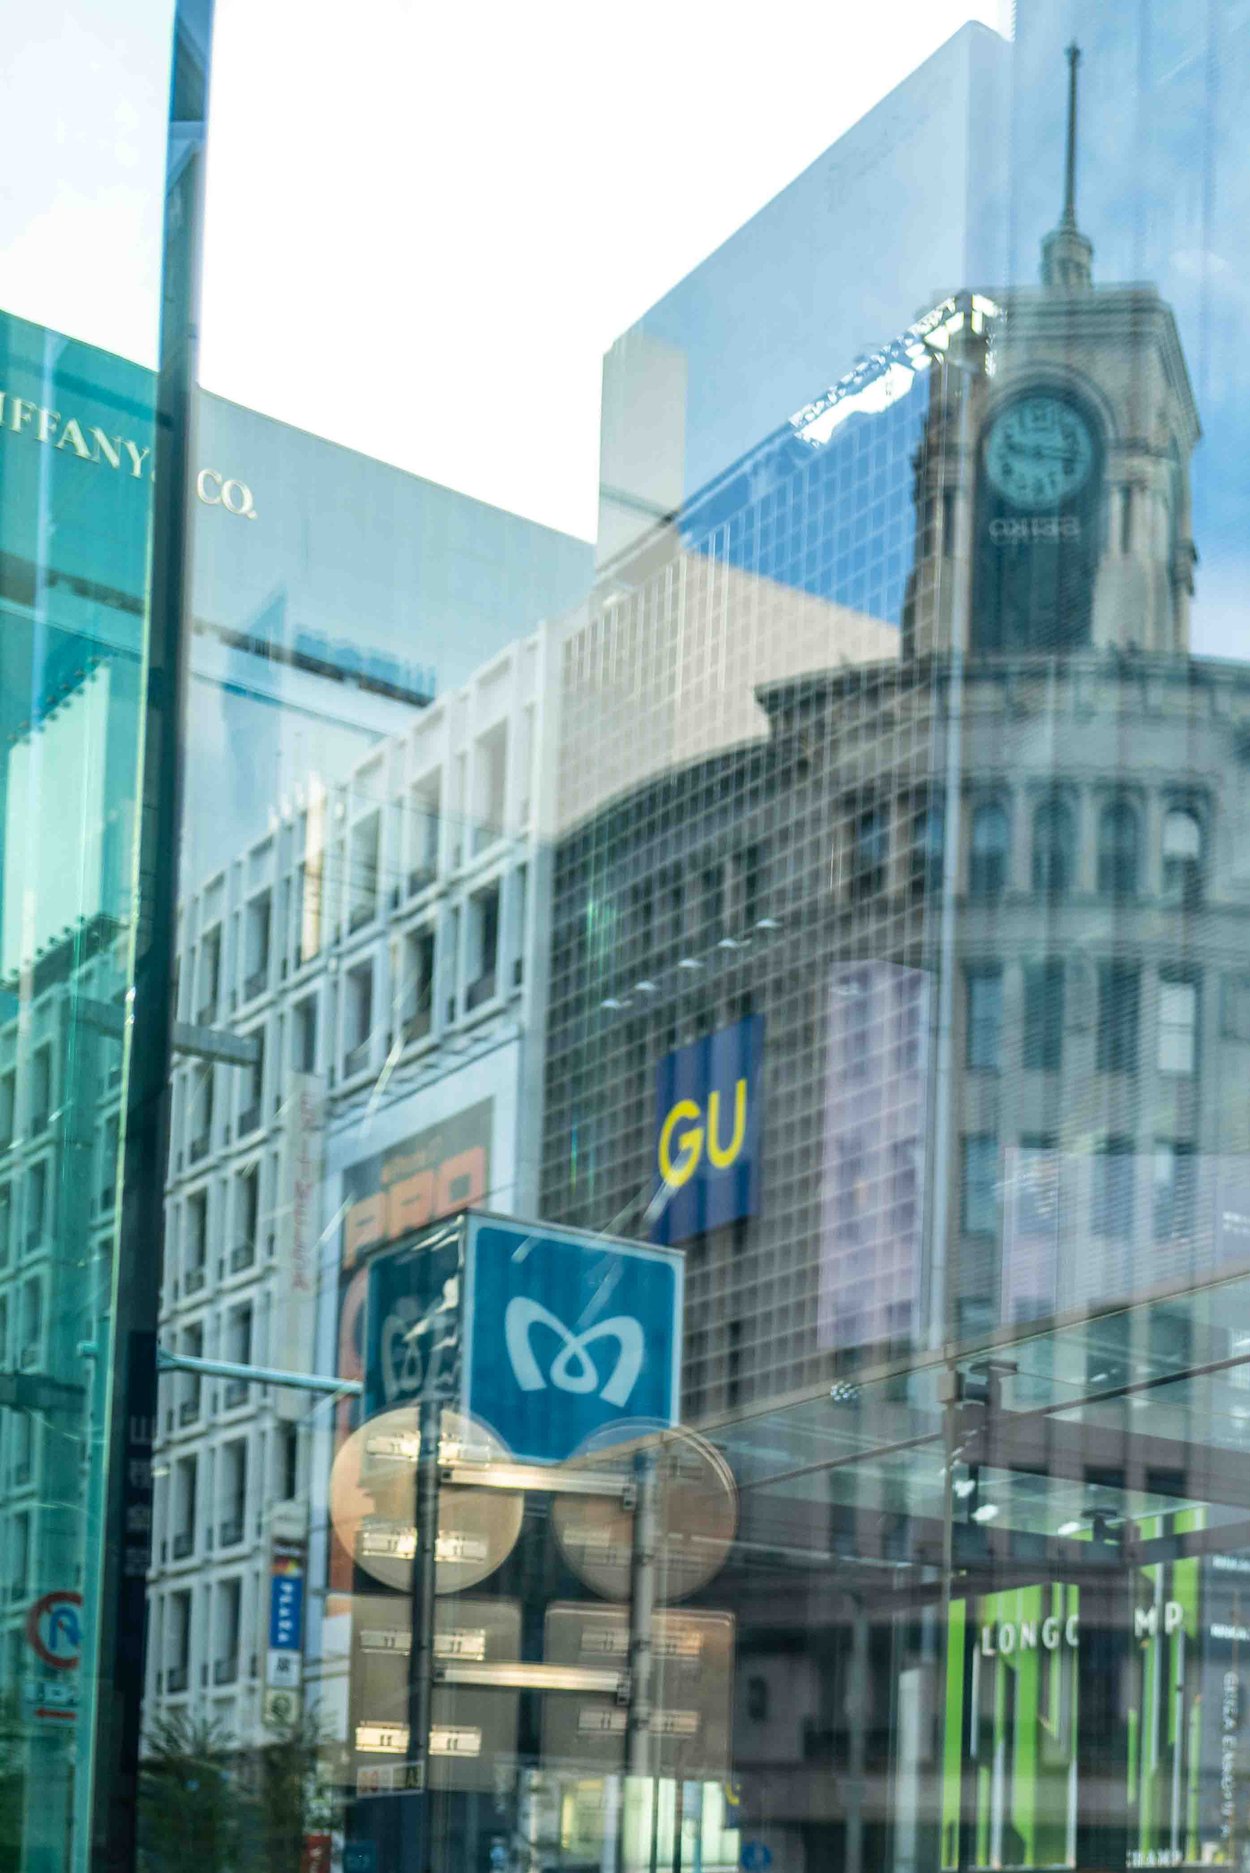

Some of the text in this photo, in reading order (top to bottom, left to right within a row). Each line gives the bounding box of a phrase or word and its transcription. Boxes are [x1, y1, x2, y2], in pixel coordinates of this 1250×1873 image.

[197, 470, 257, 519] CO.
[659, 1079, 747, 1188] GU
[981, 1601, 1184, 1657] LONGCMP
